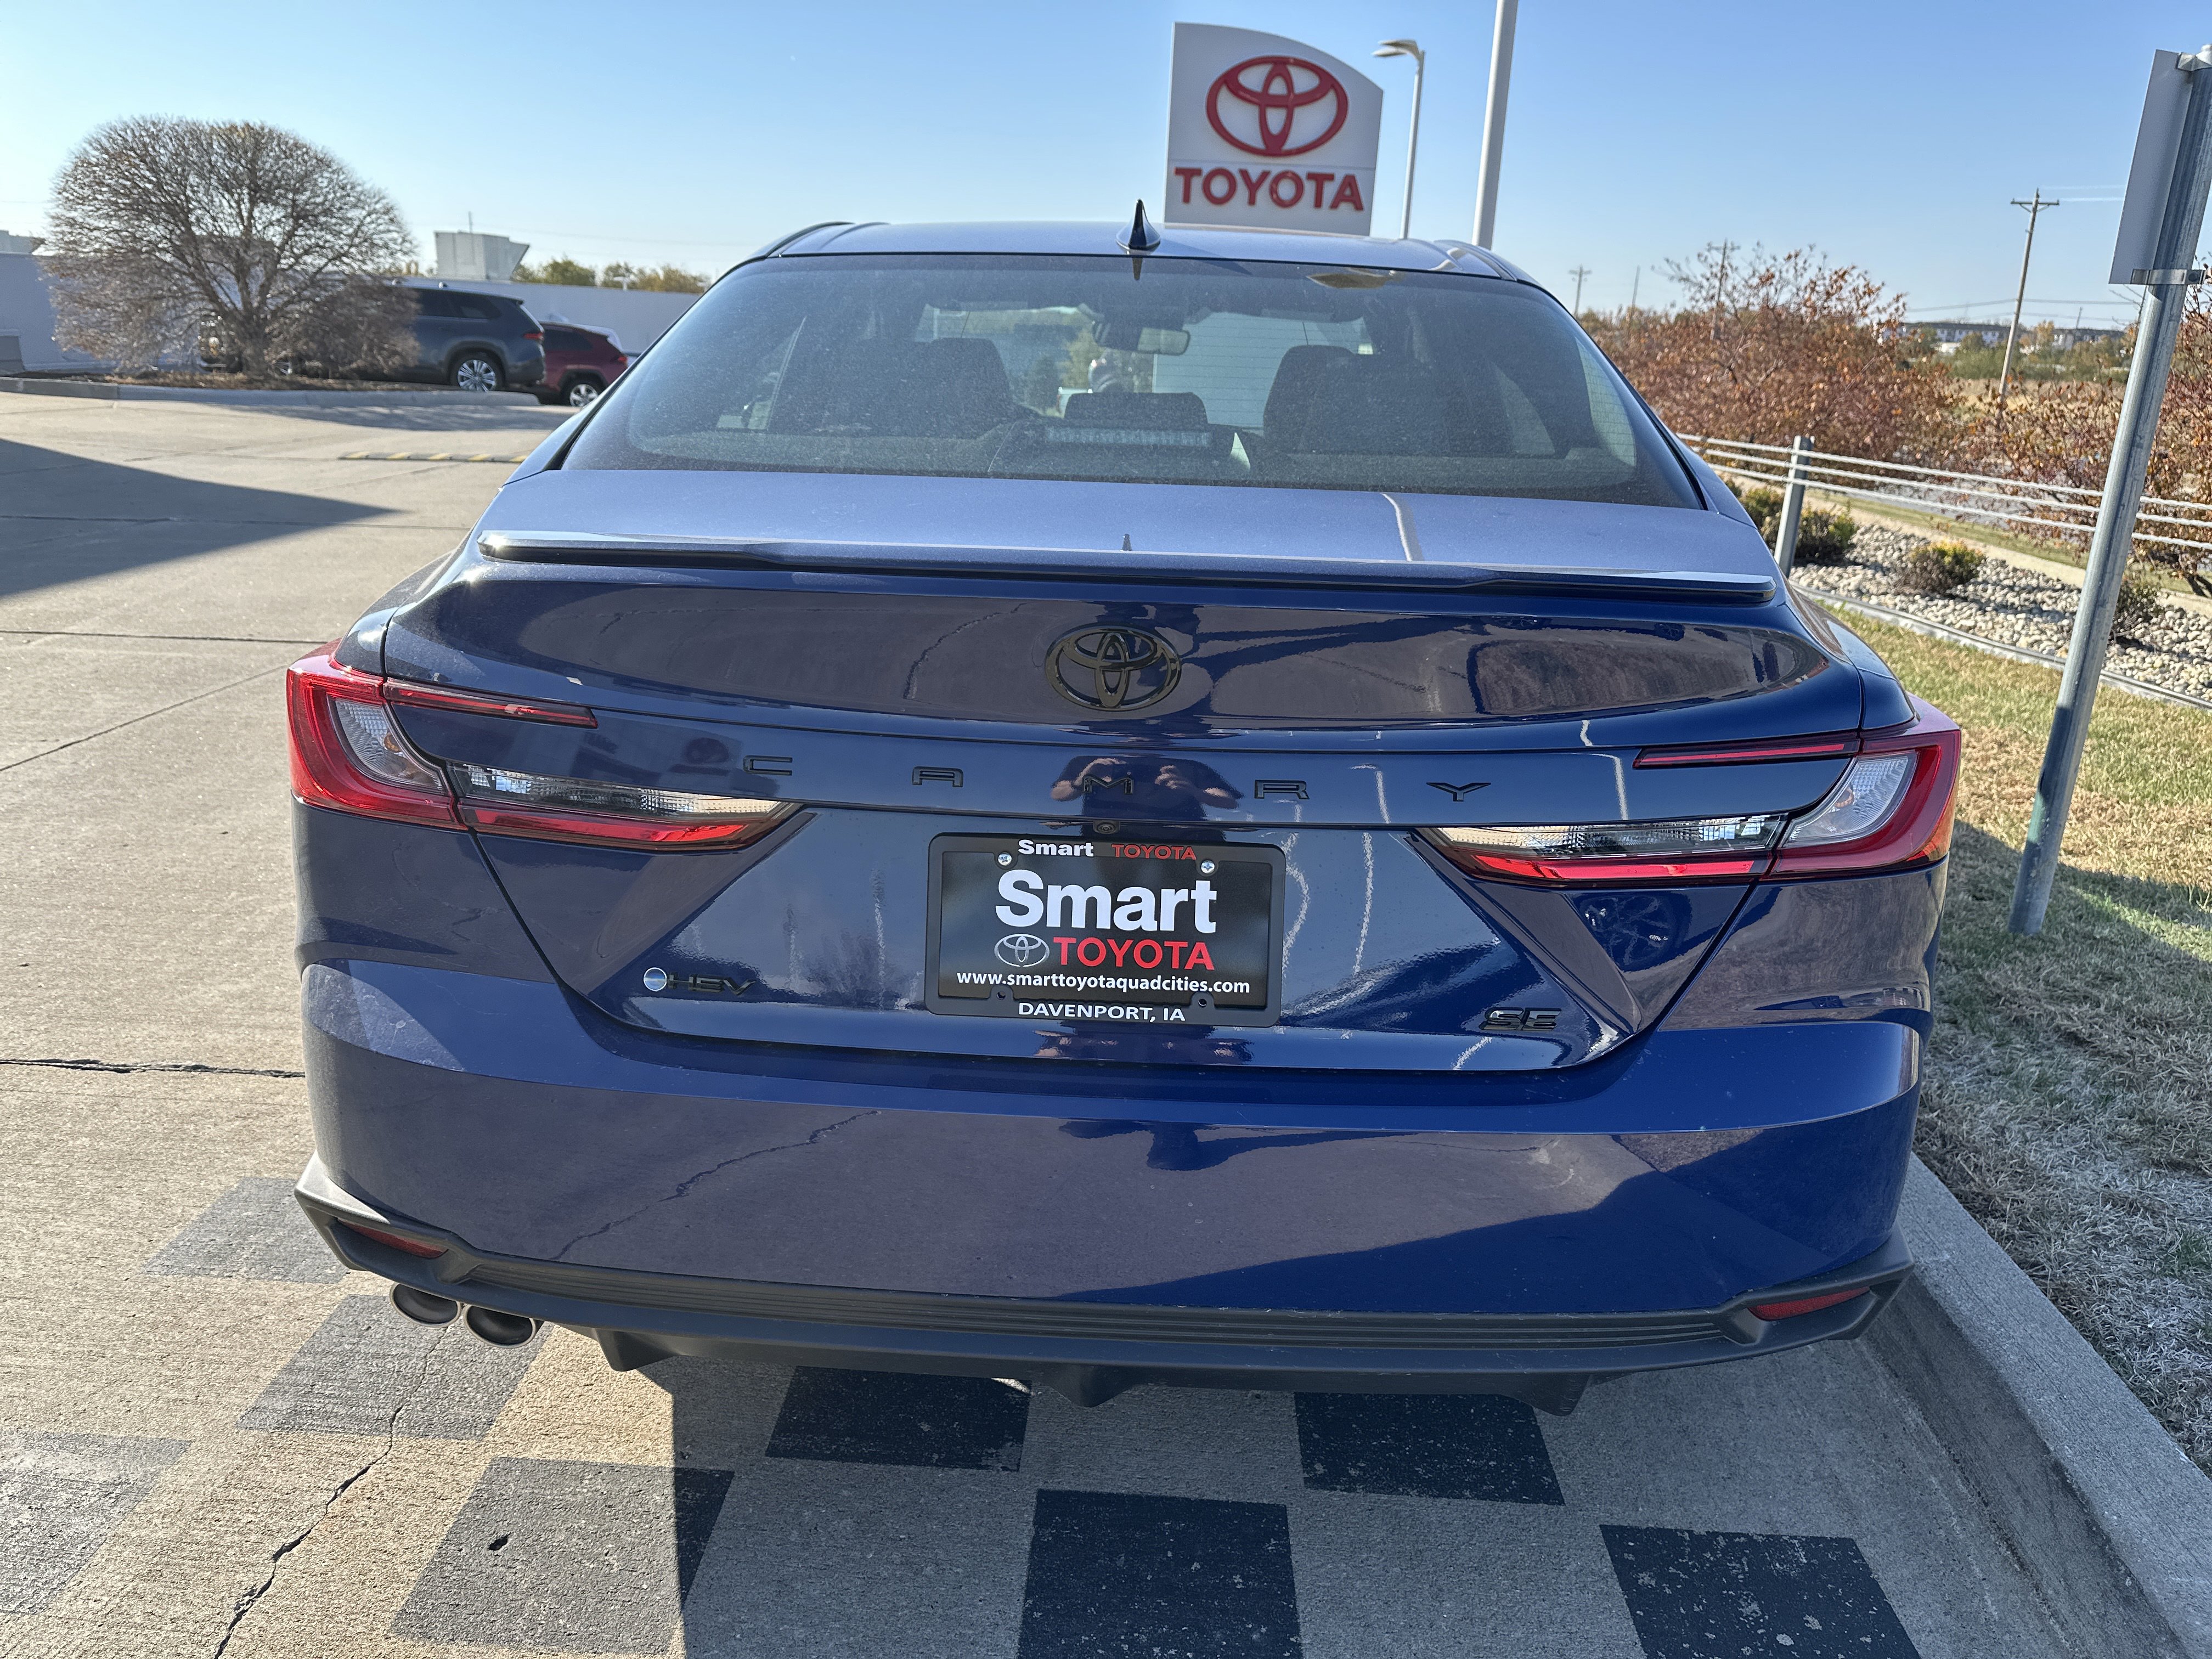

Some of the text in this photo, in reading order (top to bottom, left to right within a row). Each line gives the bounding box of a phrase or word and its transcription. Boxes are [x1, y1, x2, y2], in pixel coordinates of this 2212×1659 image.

[1174, 167, 1364, 211] TOYOTA
[743, 754, 1492, 802] CAMRY
[1018, 839, 1197, 860] Smart TOYOTA
[995, 869, 1217, 934] Smart
[1053, 936, 1215, 970] TOYOTA
[667, 970, 757, 996] HEV
[956, 970, 1250, 994] www.smarttoyotaquadcities.com
[1018, 1002, 1186, 1023] DAVENPORT, IA
[1478, 1006, 1562, 1031] SE
